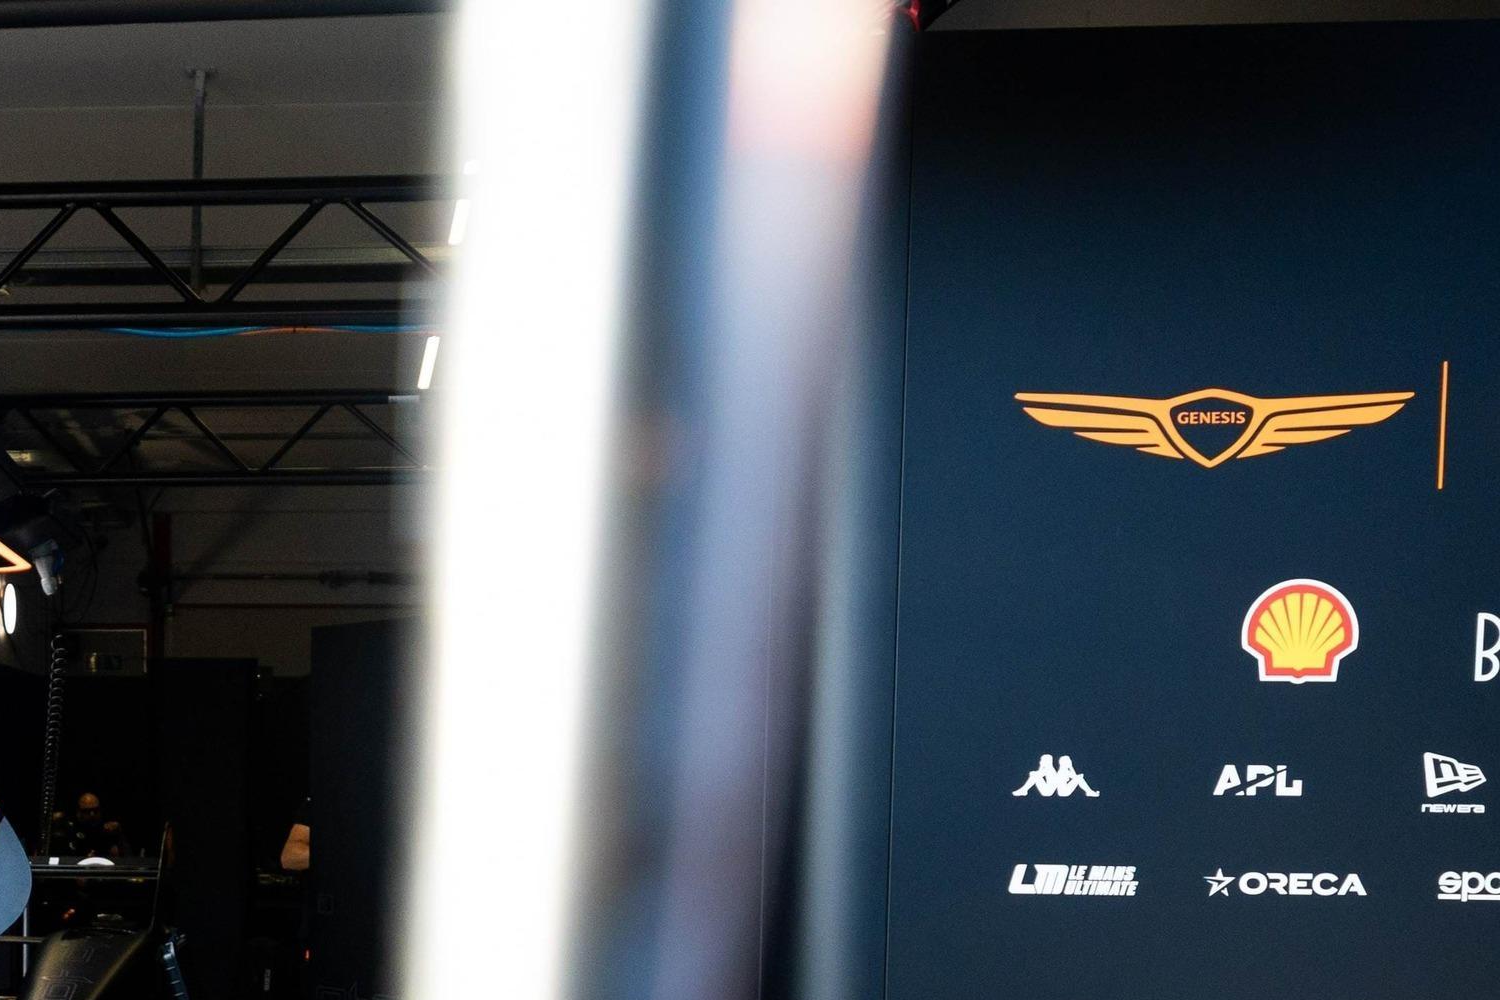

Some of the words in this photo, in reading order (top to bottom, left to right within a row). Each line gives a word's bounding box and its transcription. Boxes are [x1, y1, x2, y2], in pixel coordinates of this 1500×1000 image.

[1177, 411, 1246, 425] GENESIS
[1213, 764, 1303, 796] APL
[1068, 865, 1088, 880] LE
[1088, 865, 1137, 881] MANS
[1063, 881, 1139, 896] ULTIMATE
[1238, 871, 1367, 896] ORECA
